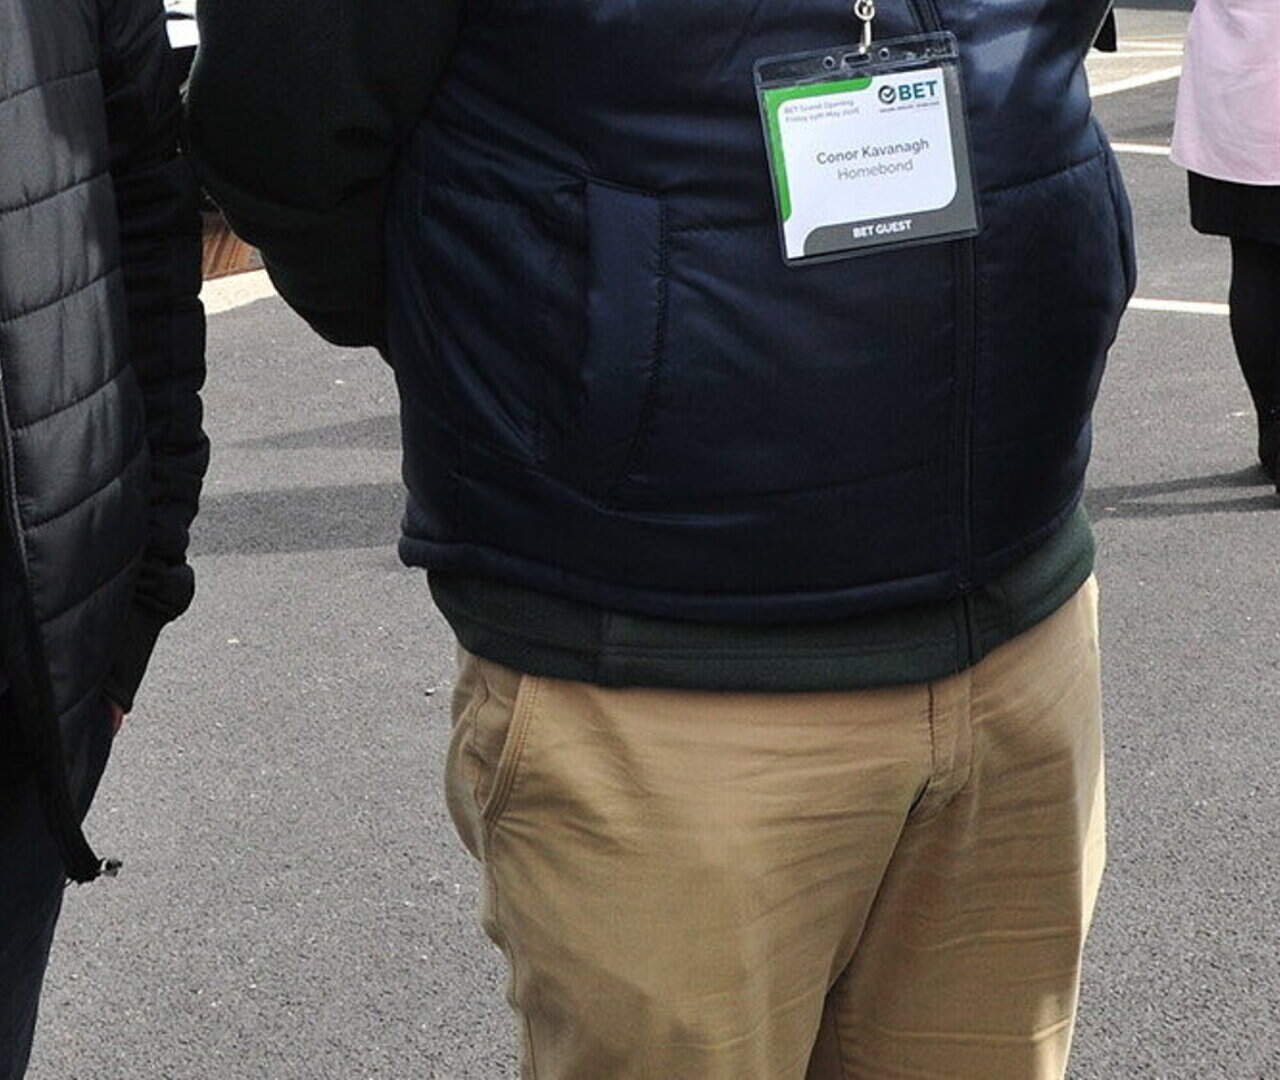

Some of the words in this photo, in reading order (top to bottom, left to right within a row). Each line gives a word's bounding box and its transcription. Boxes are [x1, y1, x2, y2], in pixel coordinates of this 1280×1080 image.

[898, 80, 938, 102] BET
[817, 149, 858, 165] Conor
[861, 139, 930, 160] Kavanagh
[837, 159, 913, 181] Homebond
[853, 224, 874, 239] BET
[875, 219, 913, 236] GUEST
